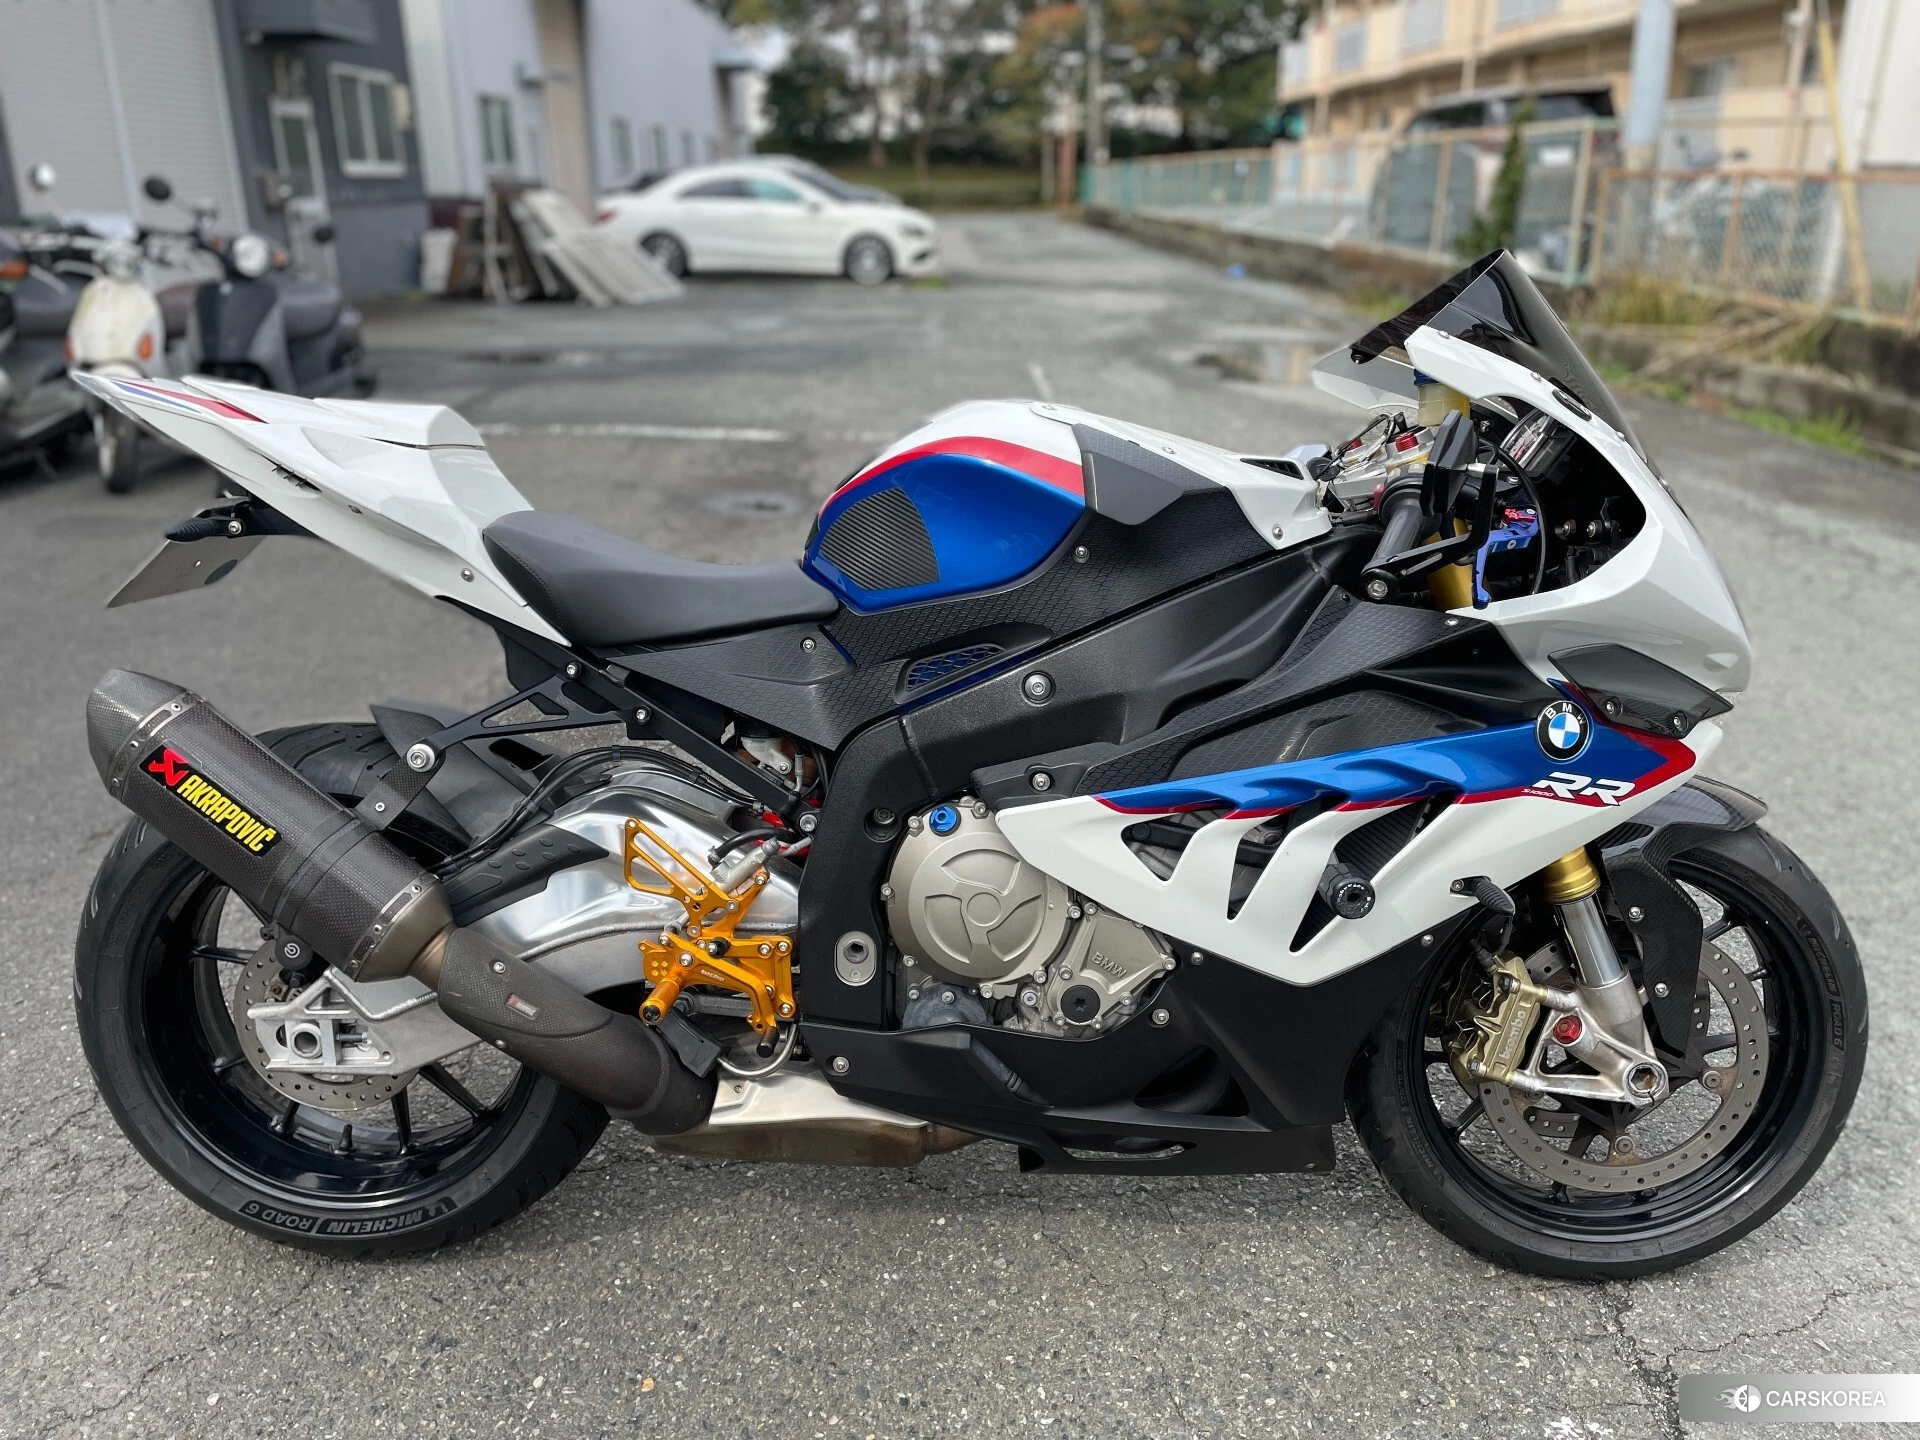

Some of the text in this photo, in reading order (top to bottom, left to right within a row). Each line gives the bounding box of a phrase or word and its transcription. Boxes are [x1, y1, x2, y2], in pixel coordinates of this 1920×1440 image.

[1545, 703, 1586, 725] BMW
[1532, 771, 1636, 806] RR
[176, 774, 277, 852] AKRAPOVIČ
[1092, 952, 1128, 979] BMW
[1499, 1010, 1527, 1060] brembo
[1831, 1003, 1843, 1036] ROAD
[245, 1203, 423, 1234] MICHELIN ROAD 6
